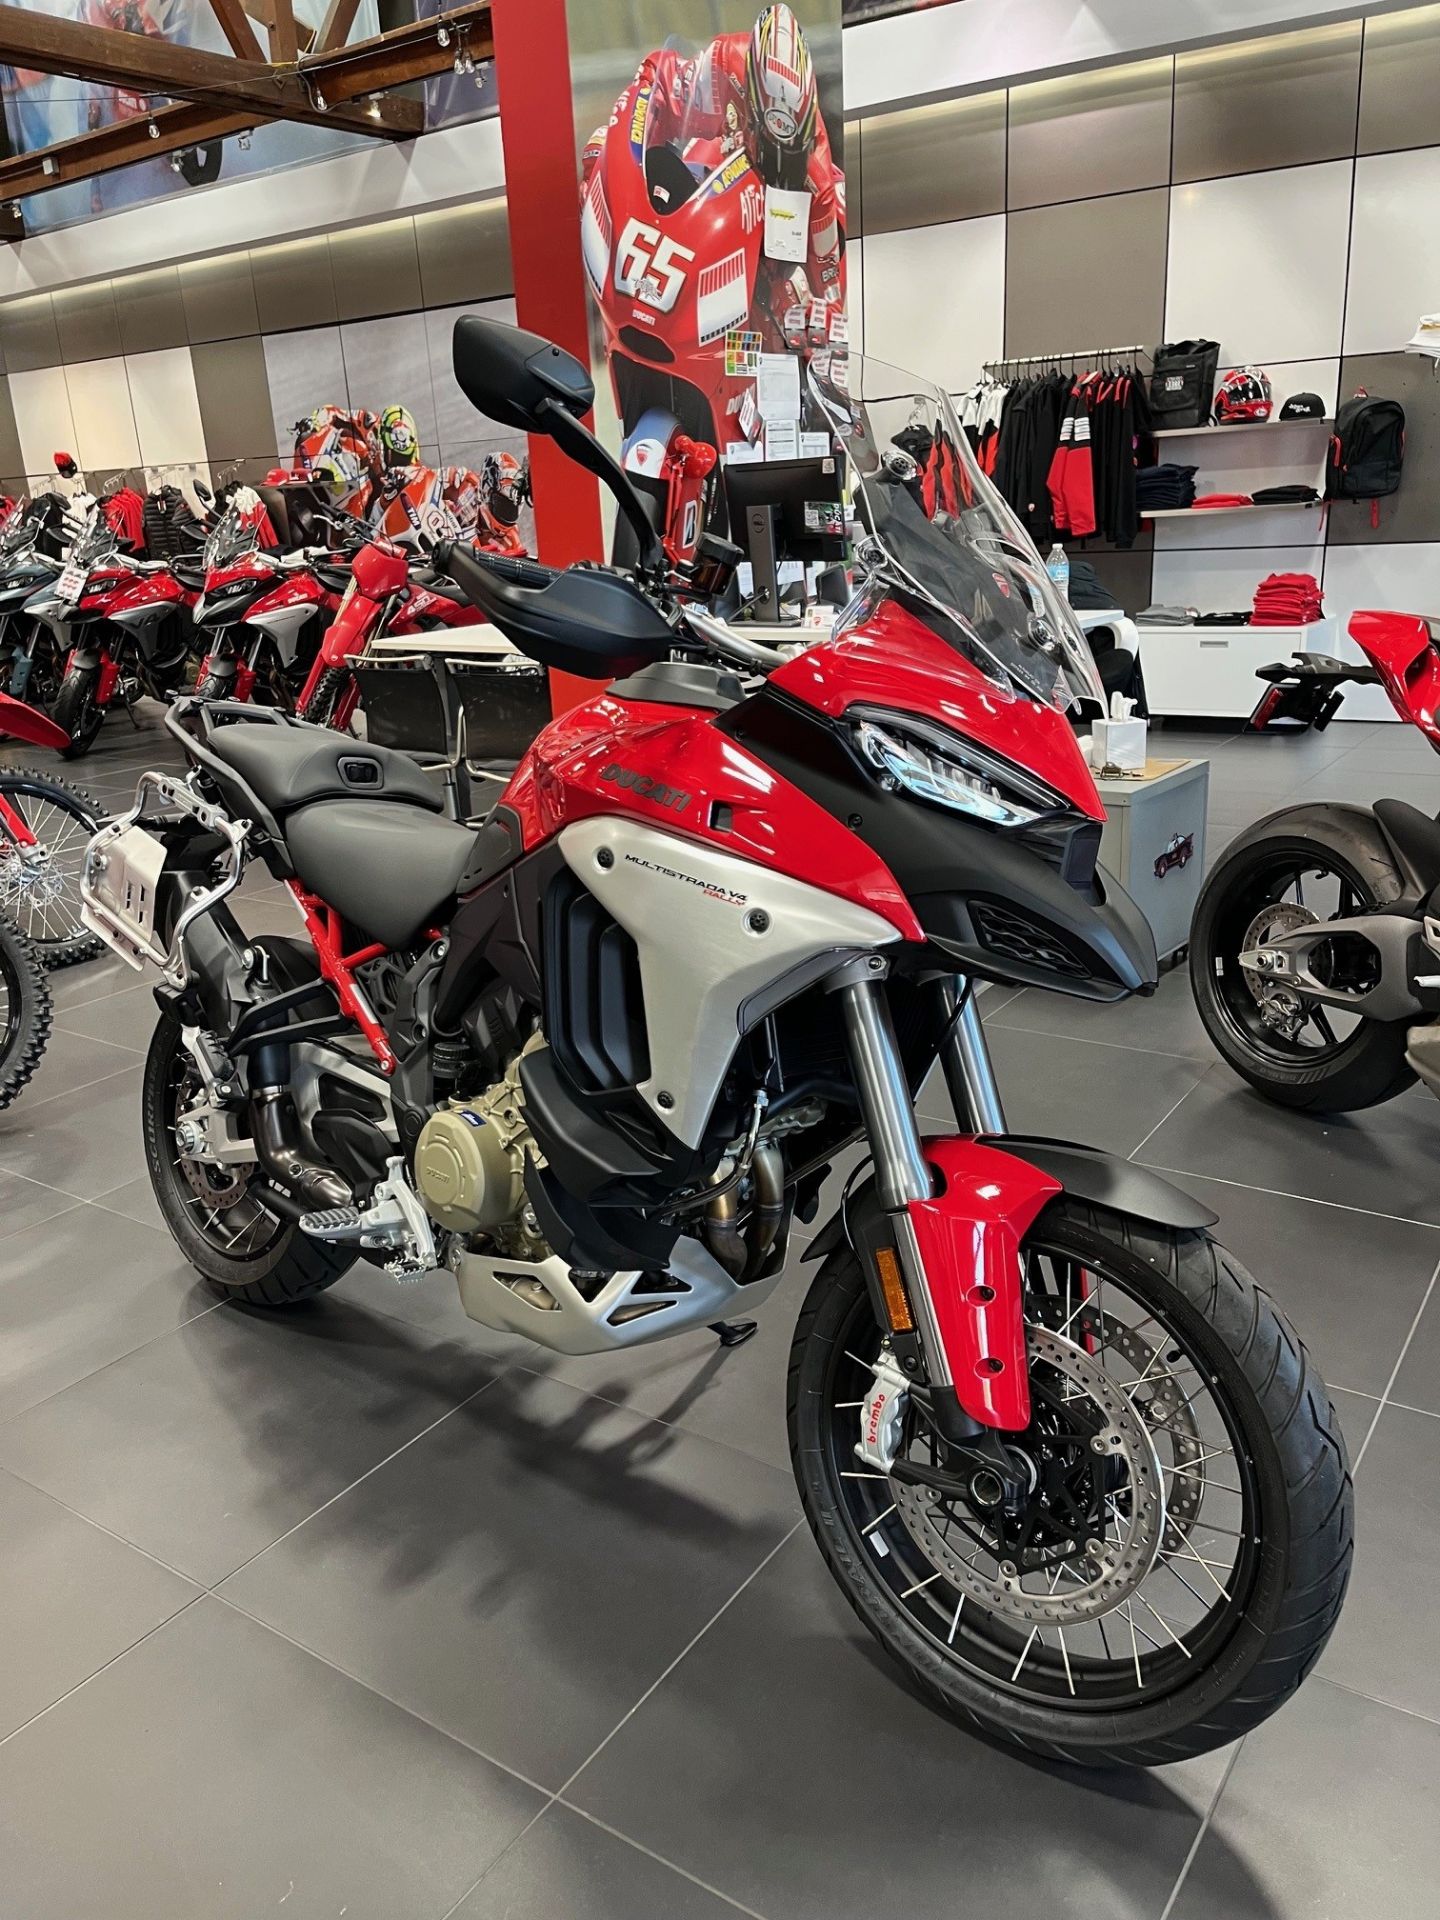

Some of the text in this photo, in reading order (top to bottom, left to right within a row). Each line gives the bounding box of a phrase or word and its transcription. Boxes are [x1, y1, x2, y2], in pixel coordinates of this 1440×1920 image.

[614, 216, 696, 313] 65
[407, 506, 421, 528] TIM
[601, 763, 692, 813] DUCATI
[624, 854, 748, 902] MULTISTRADA V4
[702, 888, 746, 906] RALLY
[867, 1393, 886, 1443] brembo
